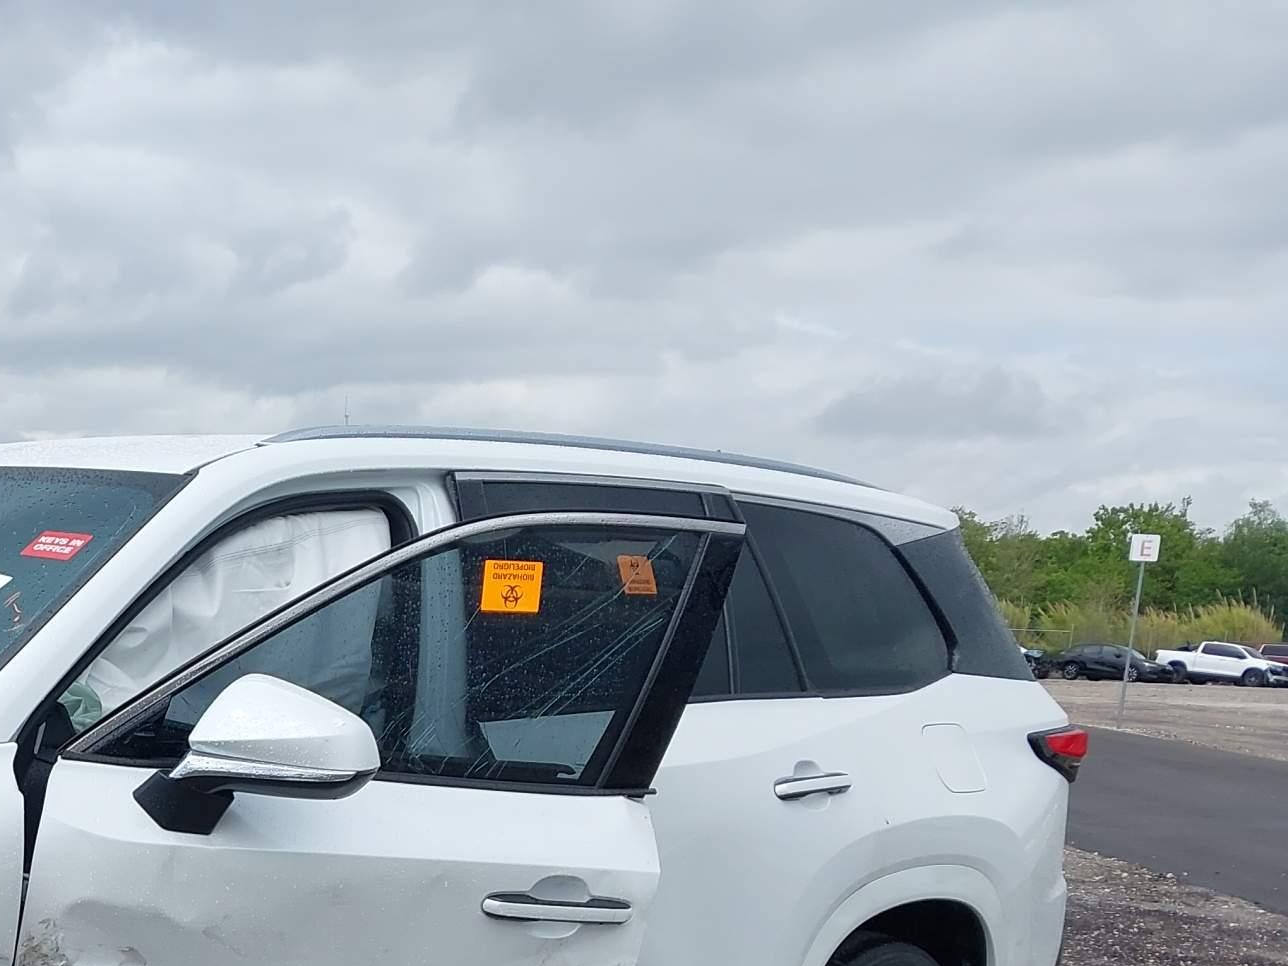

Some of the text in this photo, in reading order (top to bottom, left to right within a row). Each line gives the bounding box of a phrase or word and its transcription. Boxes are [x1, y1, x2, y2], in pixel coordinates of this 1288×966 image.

[38, 535, 85, 547] KEYS IN
[33, 543, 74, 554] OFFICE
[1140, 540, 1153, 557] E
[493, 562, 536, 571] BIOPELIGRO
[492, 572, 535, 581] BIOHAZARD
